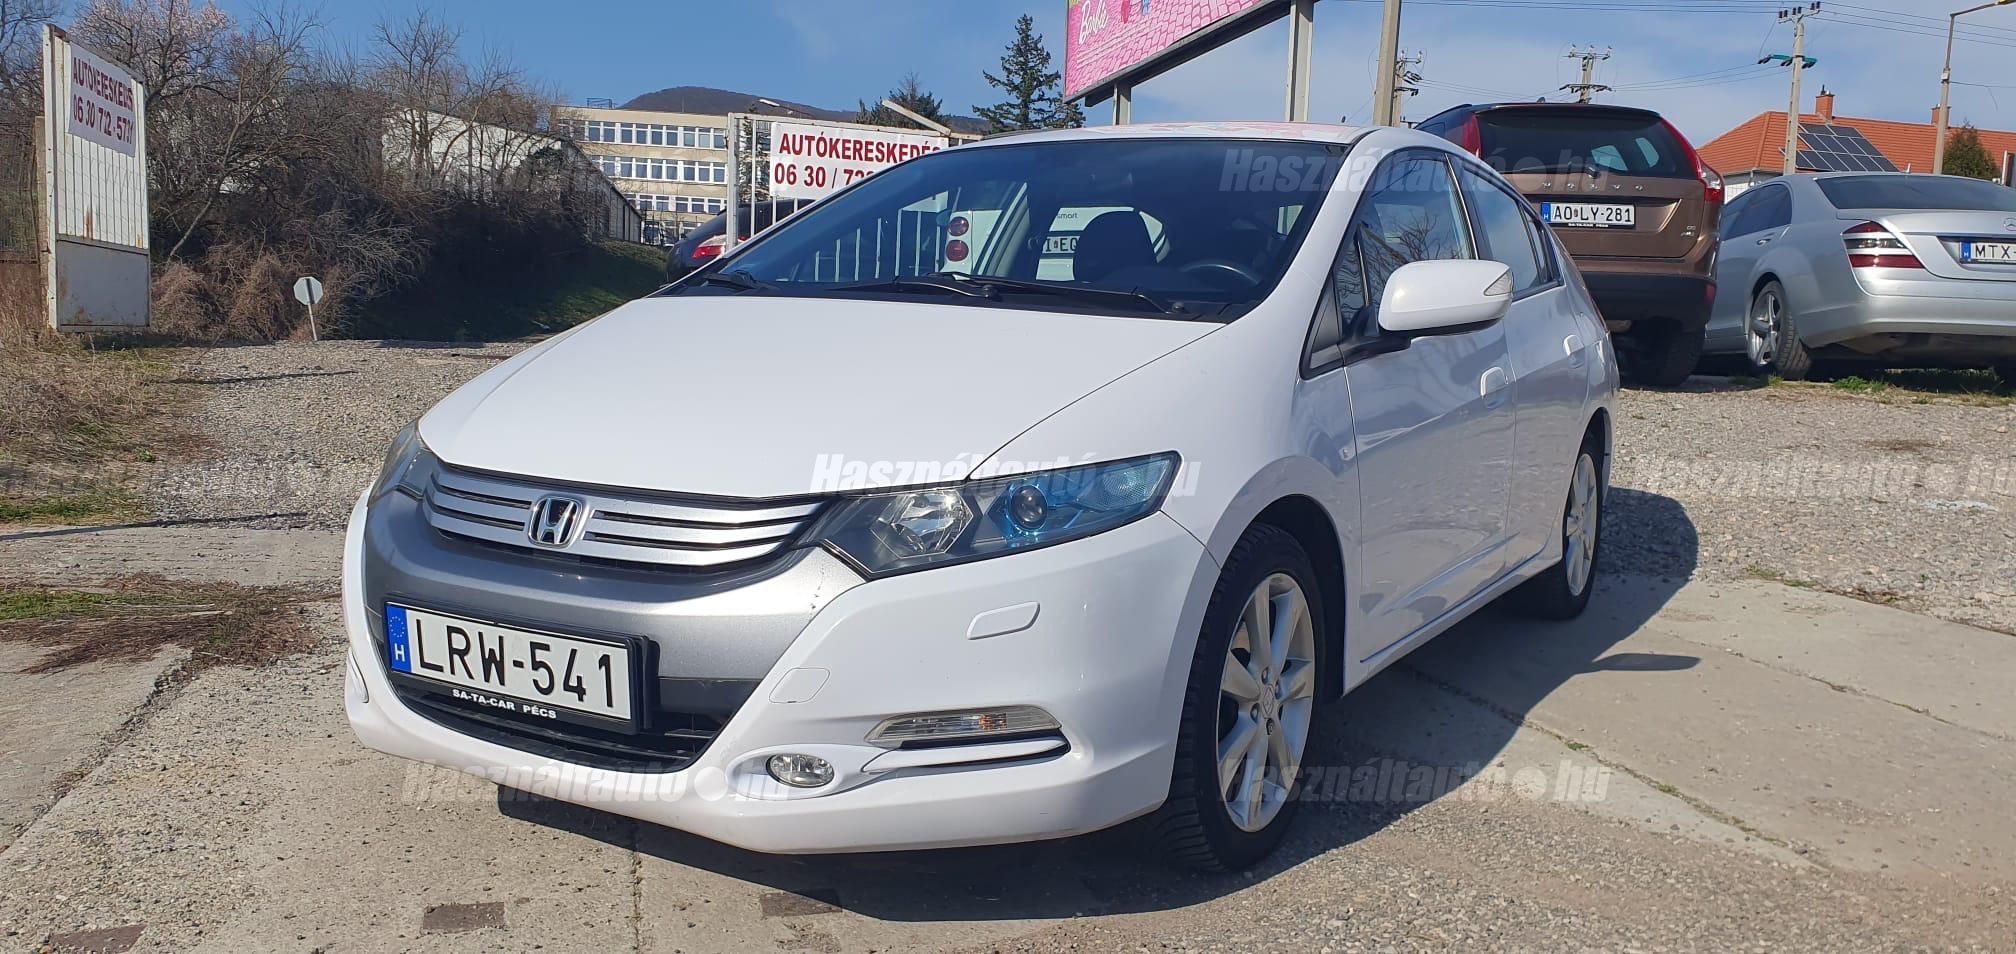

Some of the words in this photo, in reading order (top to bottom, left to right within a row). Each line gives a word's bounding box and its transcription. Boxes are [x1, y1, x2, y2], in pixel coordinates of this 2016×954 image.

[774, 162, 797, 186] 06
[803, 165, 826, 188] 30
[415, 618, 613, 708] LRW-541
[452, 687, 516, 712] SA-TA-CAR
[522, 703, 557, 719] PÉCS
